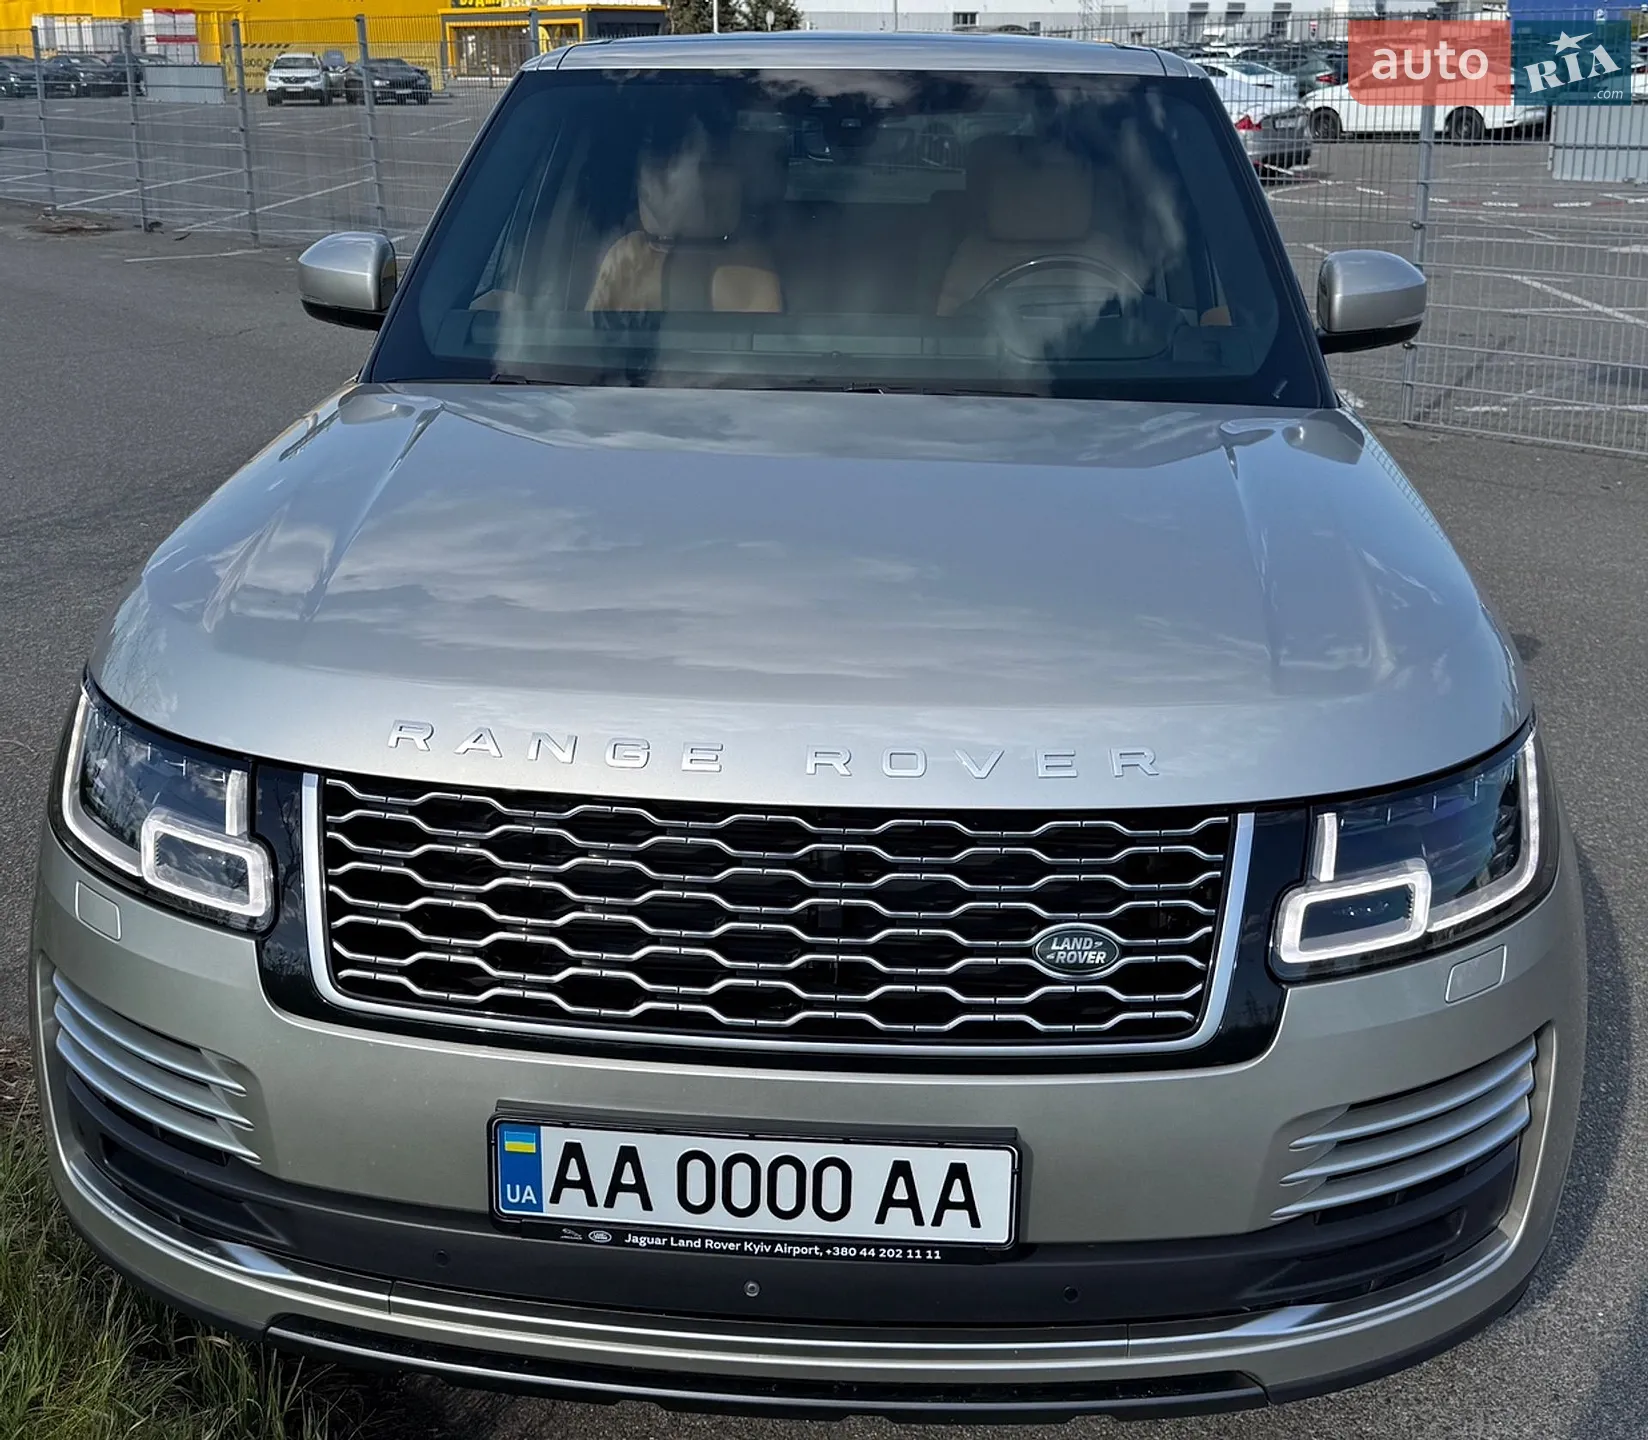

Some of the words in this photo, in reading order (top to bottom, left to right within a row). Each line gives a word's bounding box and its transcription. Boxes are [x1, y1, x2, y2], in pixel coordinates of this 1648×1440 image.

[387, 719, 724, 773] RANGE
[805, 745, 1160, 780] ROVER
[1051, 937, 1094, 950] LAND
[1055, 951, 1107, 964] ROVER
[506, 1183, 537, 1204] UA
[549, 1141, 653, 1212] AA
[676, 1149, 852, 1222] 0000
[874, 1160, 982, 1229] AA
[624, 1233, 668, 1247] Jaguar
[670, 1237, 701, 1248] Land
[704, 1239, 741, 1251] Rover
[743, 1241, 772, 1255] Kyiv
[774, 1243, 823, 1257] Airport,
[825, 1246, 857, 1257] +380
[859, 1247, 876, 1257] 44
[878, 1248, 903, 1258] 202
[906, 1249, 922, 1259] 11
[925, 1249, 942, 1260] 11
